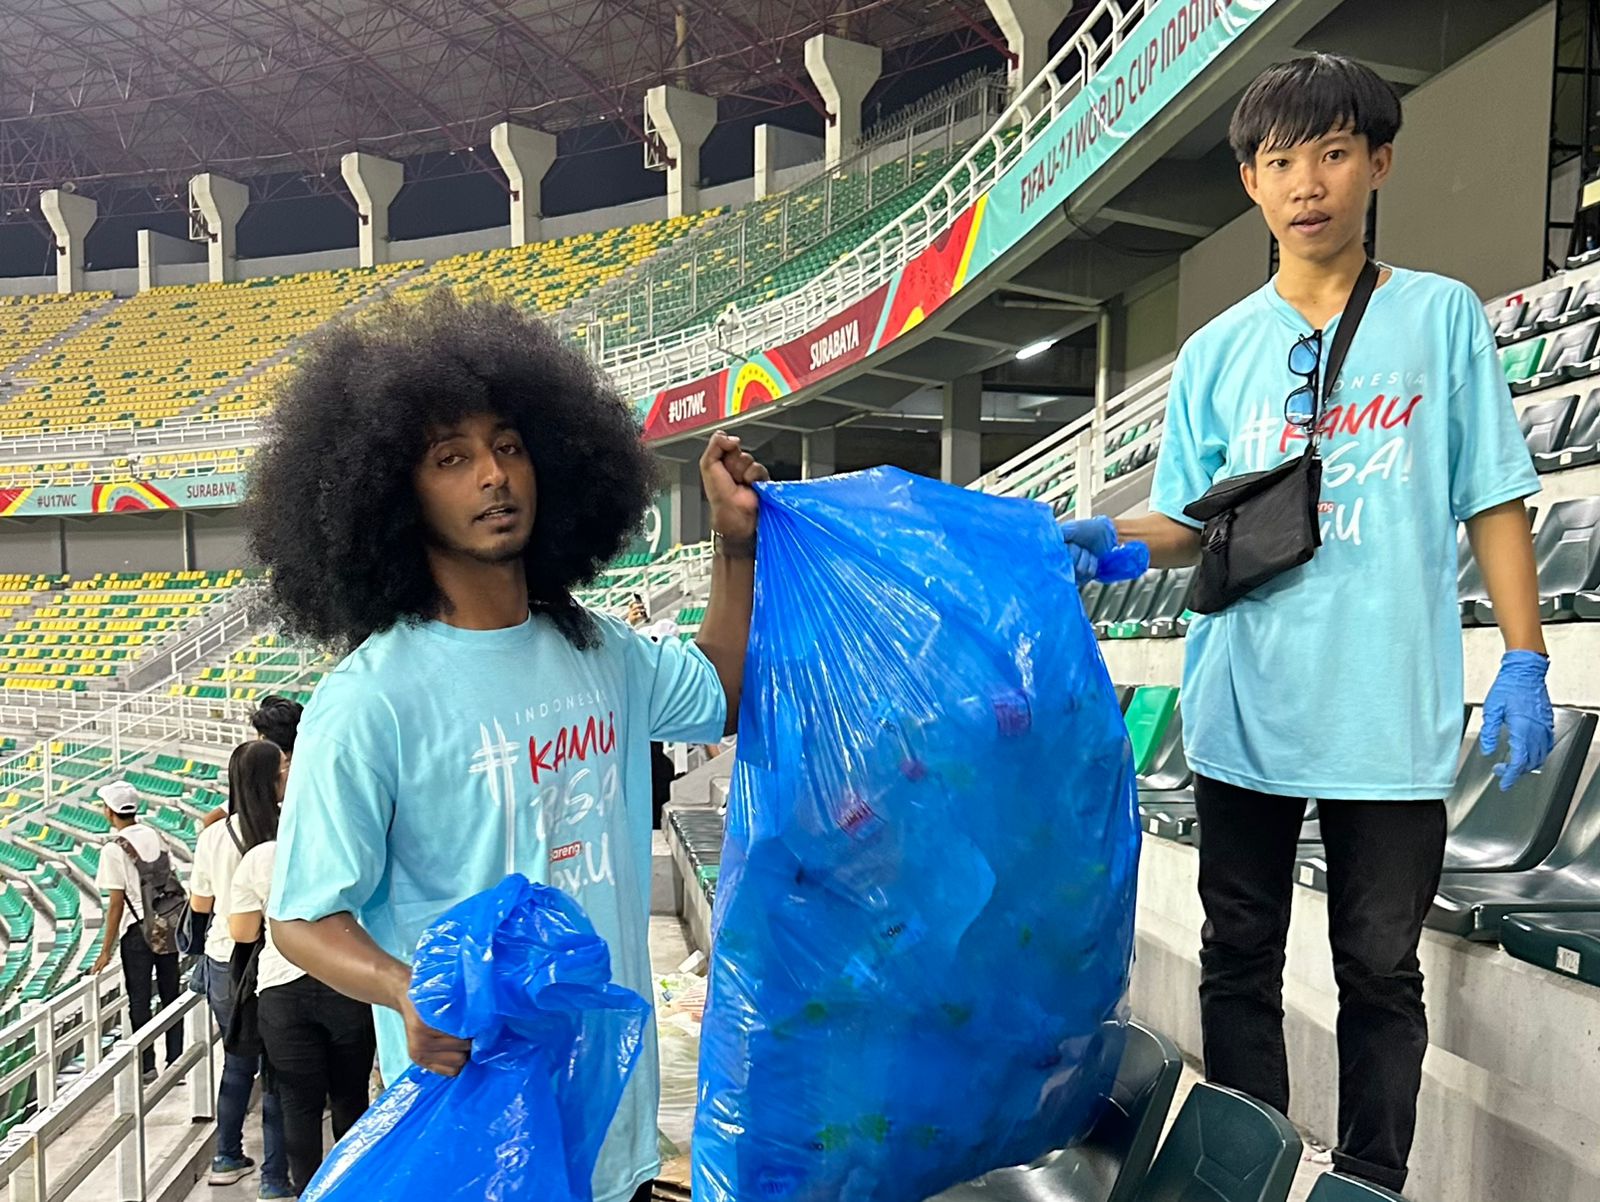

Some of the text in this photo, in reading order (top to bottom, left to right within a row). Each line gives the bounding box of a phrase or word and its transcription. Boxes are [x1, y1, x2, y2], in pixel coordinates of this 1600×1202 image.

[1020, 159, 1045, 214] FIFA
[1047, 127, 1073, 187] U-17
[1075, 76, 1125, 159] WORLD
[1128, 37, 1158, 104] CUP
[809, 319, 860, 370] SURABAYA
[1332, 371, 1425, 393] ONESIA
[667, 390, 707, 423] #U17WC
[37, 481, 237, 508] #U17WC SURABAYA
[550, 842, 581, 861] areng
